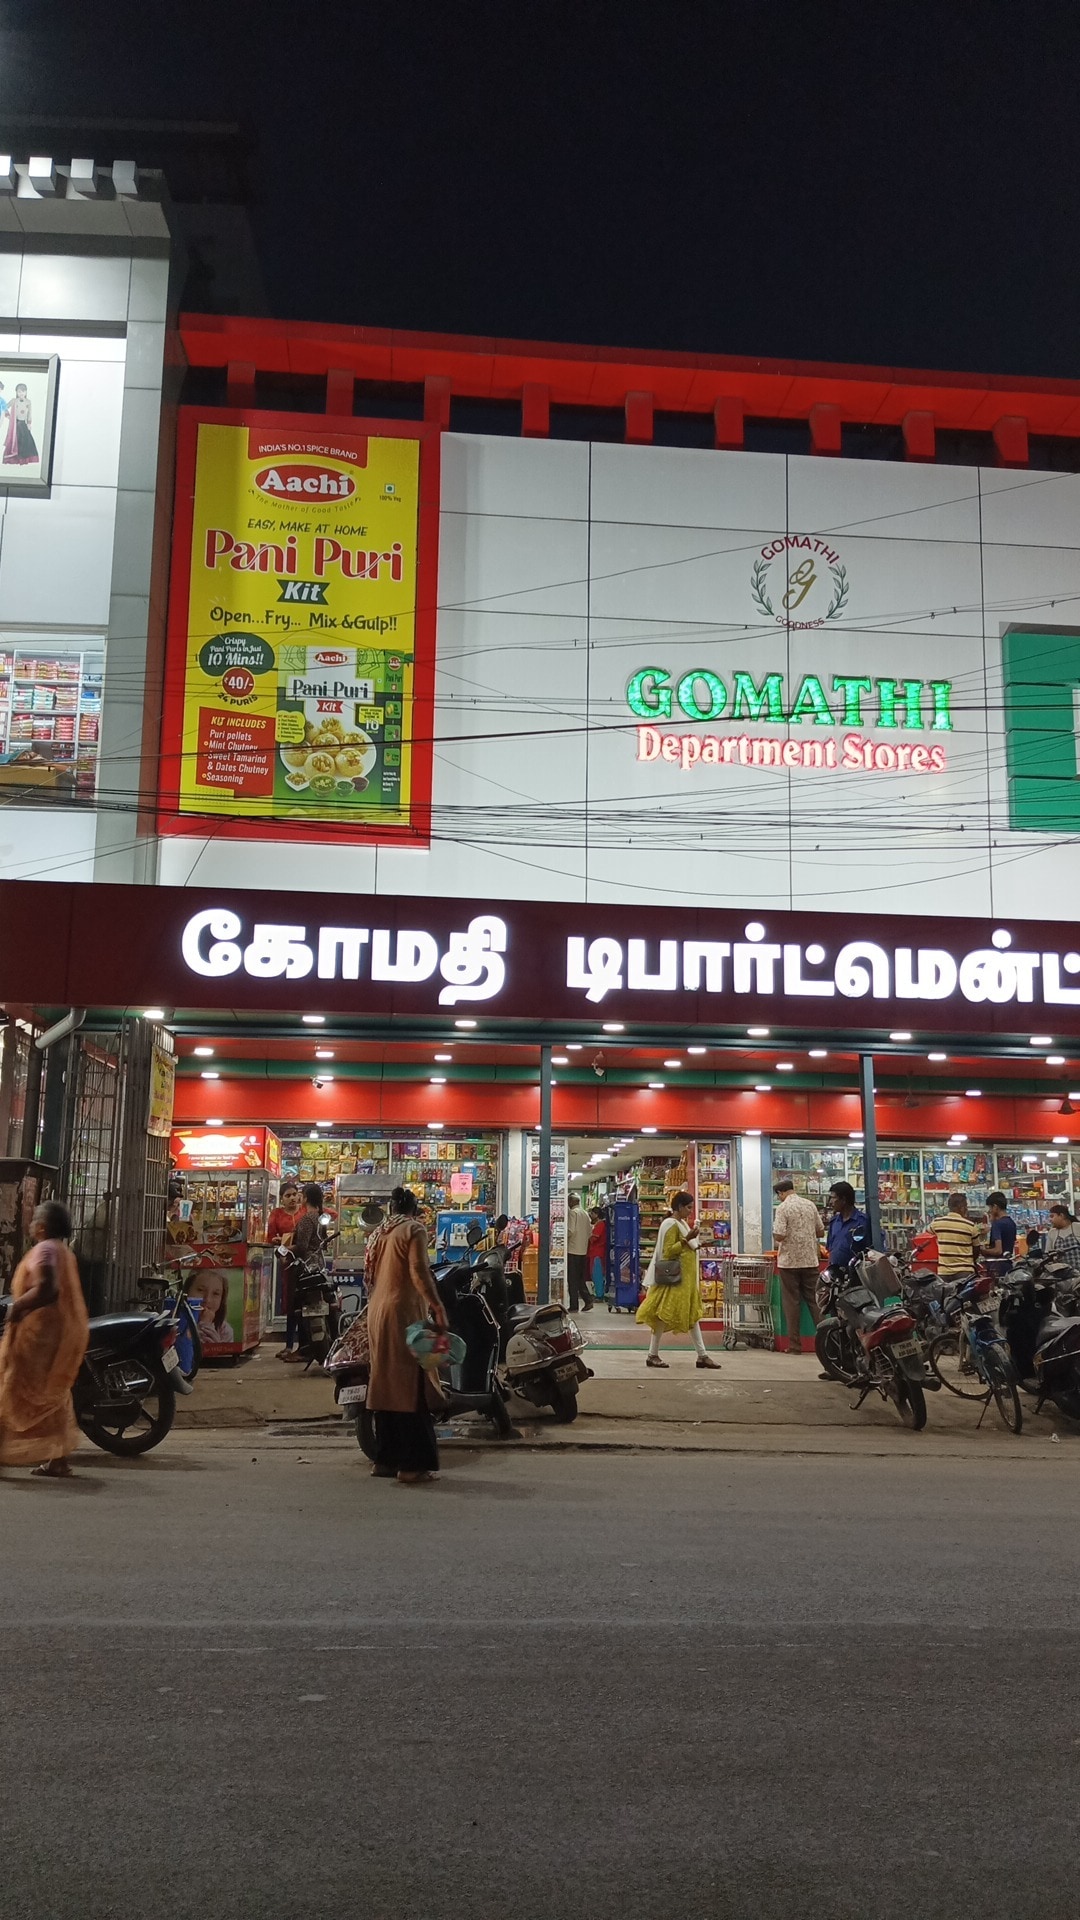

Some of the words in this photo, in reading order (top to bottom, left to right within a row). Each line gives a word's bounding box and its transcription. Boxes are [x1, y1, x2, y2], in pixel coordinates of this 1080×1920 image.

[258, 444, 287, 453] INDIA'S
[306, 445, 329, 454] SPICE
[330, 447, 358, 460] BRAND
[260, 469, 350, 496] Aachi
[247, 518, 276, 532] EASY,
[279, 521, 311, 533] MAKE
[314, 524, 330, 534] AT
[334, 524, 368, 537] HOME
[204, 528, 298, 576] Pani
[313, 536, 404, 582] Puri
[761, 535, 840, 564] GOMATHI
[284, 581, 322, 602] Kit
[309, 612, 337, 629] Mix
[776, 615, 825, 631] GOODNESS
[224, 637, 246, 646] Crispy
[208, 652, 223, 666] 10
[225, 652, 264, 666] Mins!!
[317, 653, 346, 662] Aachi
[293, 680, 328, 696] Pani
[334, 682, 368, 698] Puri
[230, 694, 259, 706] PURIS
[625, 665, 954, 732] GOMATHI
[322, 702, 337, 712] Kit
[210, 716, 226, 726] KIT
[226, 718, 267, 729] INCLUDES
[210, 729, 225, 738] Puri
[226, 731, 252, 741] pellets
[208, 740, 226, 750] Mint
[636, 722, 838, 770] Department
[841, 732, 946, 773] Stores
[208, 750, 230, 760] Sweet
[233, 752, 267, 764] Tamarind
[207, 761, 214, 770] &
[216, 762, 237, 772] Dates
[238, 764, 269, 776] Chutney
[206, 772, 244, 785] Seasoning
[182, 908, 507, 1006] கோமதி
